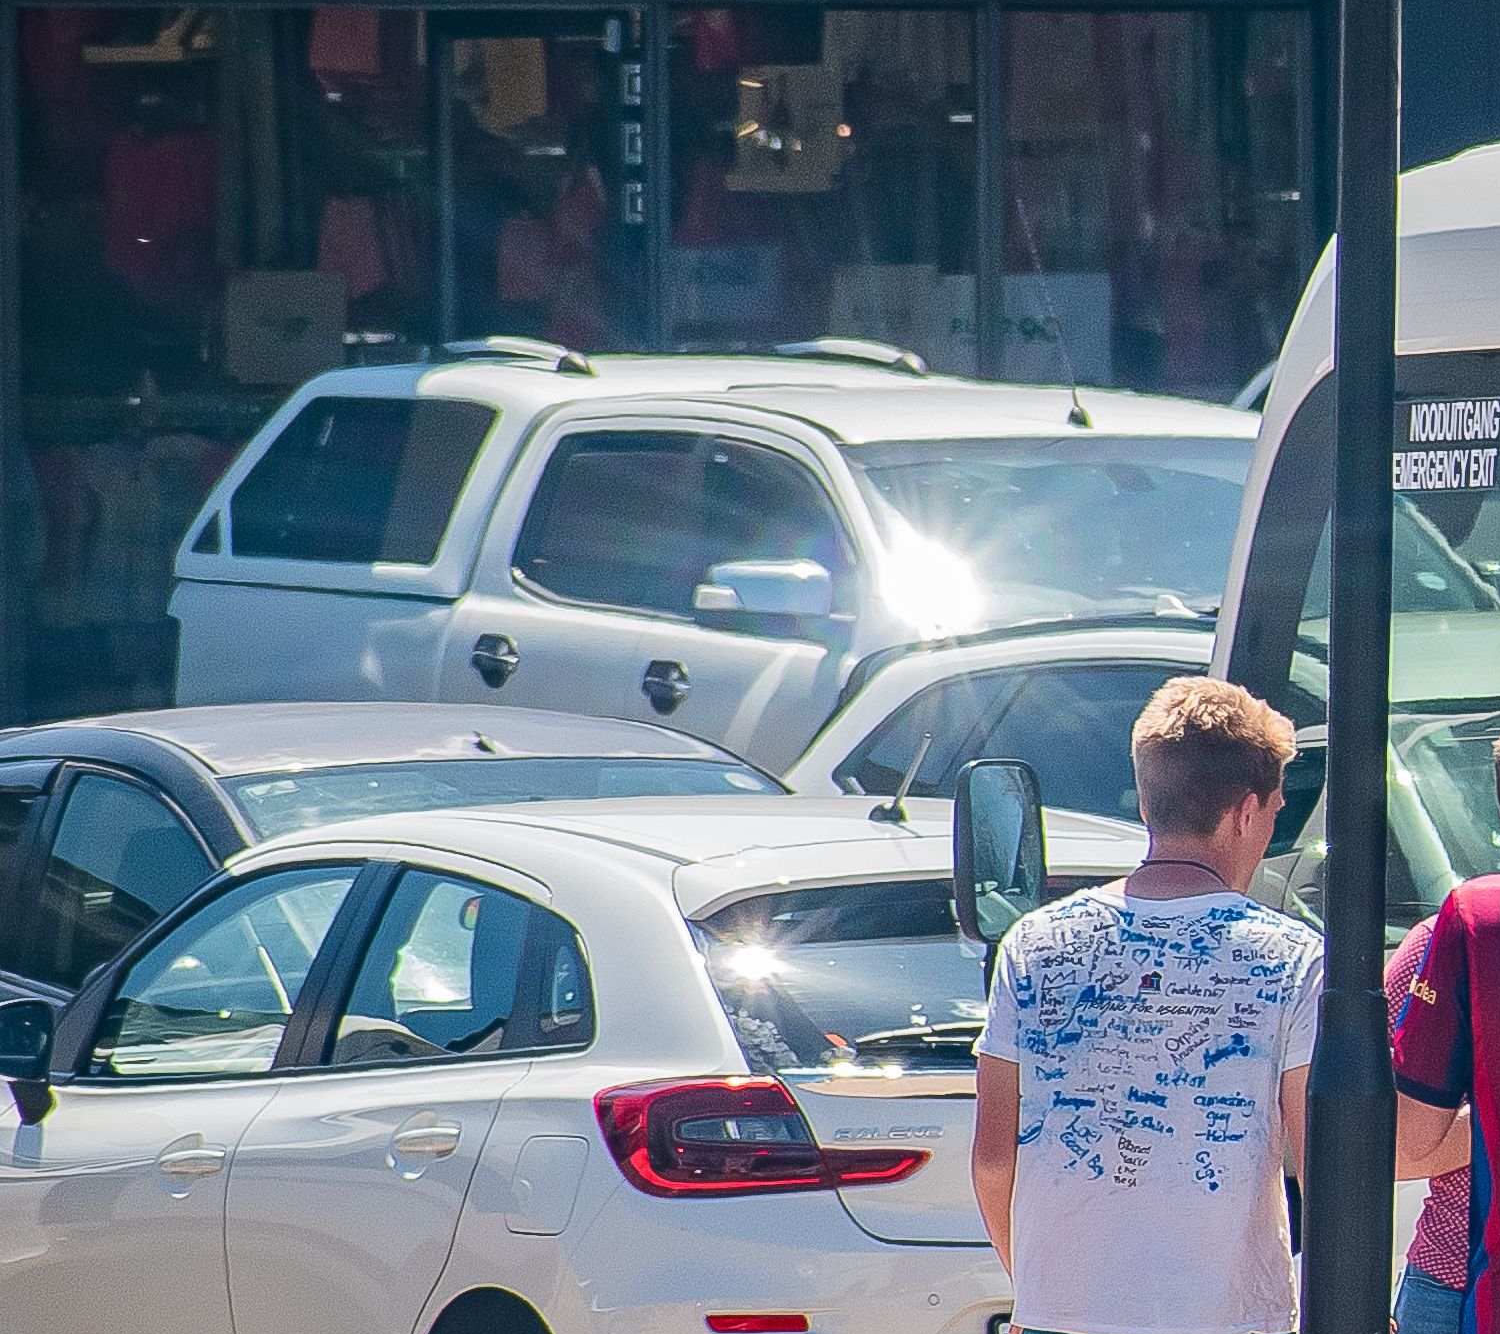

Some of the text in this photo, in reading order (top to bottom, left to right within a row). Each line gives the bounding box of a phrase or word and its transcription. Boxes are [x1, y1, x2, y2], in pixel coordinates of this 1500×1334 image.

[1409, 400, 1500, 442] NOODUITGANG
[1393, 448, 1498, 490] EMERGENCY EXIT
[1409, 973, 1436, 1005] idea
[1130, 1003, 1153, 1014] FOR
